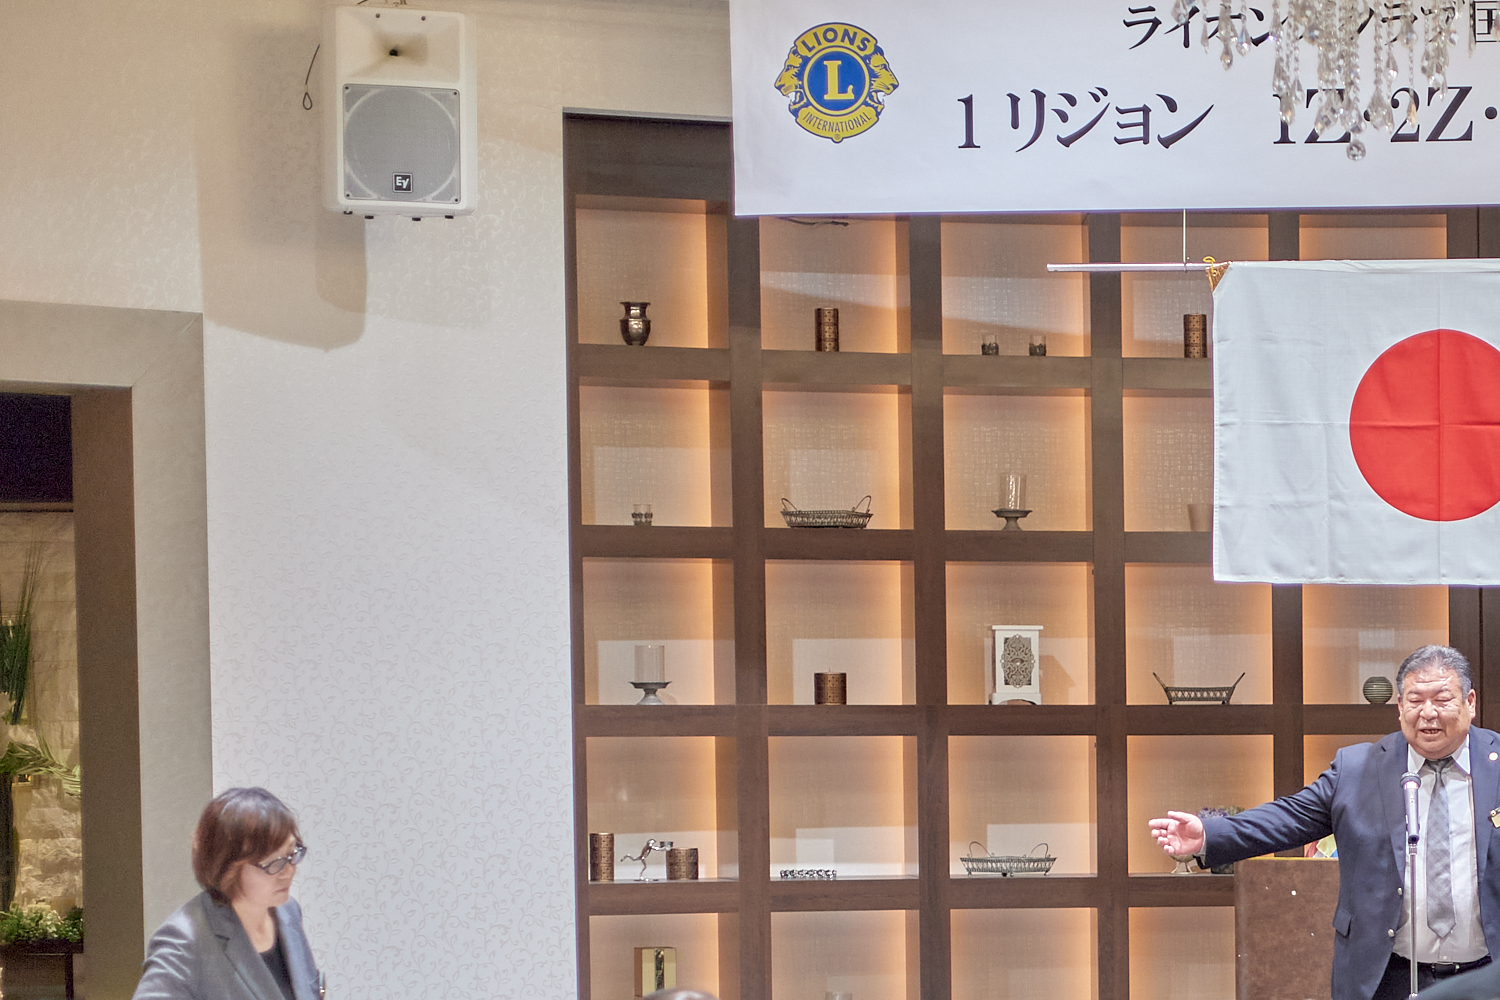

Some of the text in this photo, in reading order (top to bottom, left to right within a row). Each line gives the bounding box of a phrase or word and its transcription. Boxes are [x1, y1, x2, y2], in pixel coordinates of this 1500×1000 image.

[801, 27, 871, 53] LIONS
[823, 60, 855, 100] L
[803, 111, 872, 132] INTERNATIONAL
[1006, 86, 1215, 153] リジョン
